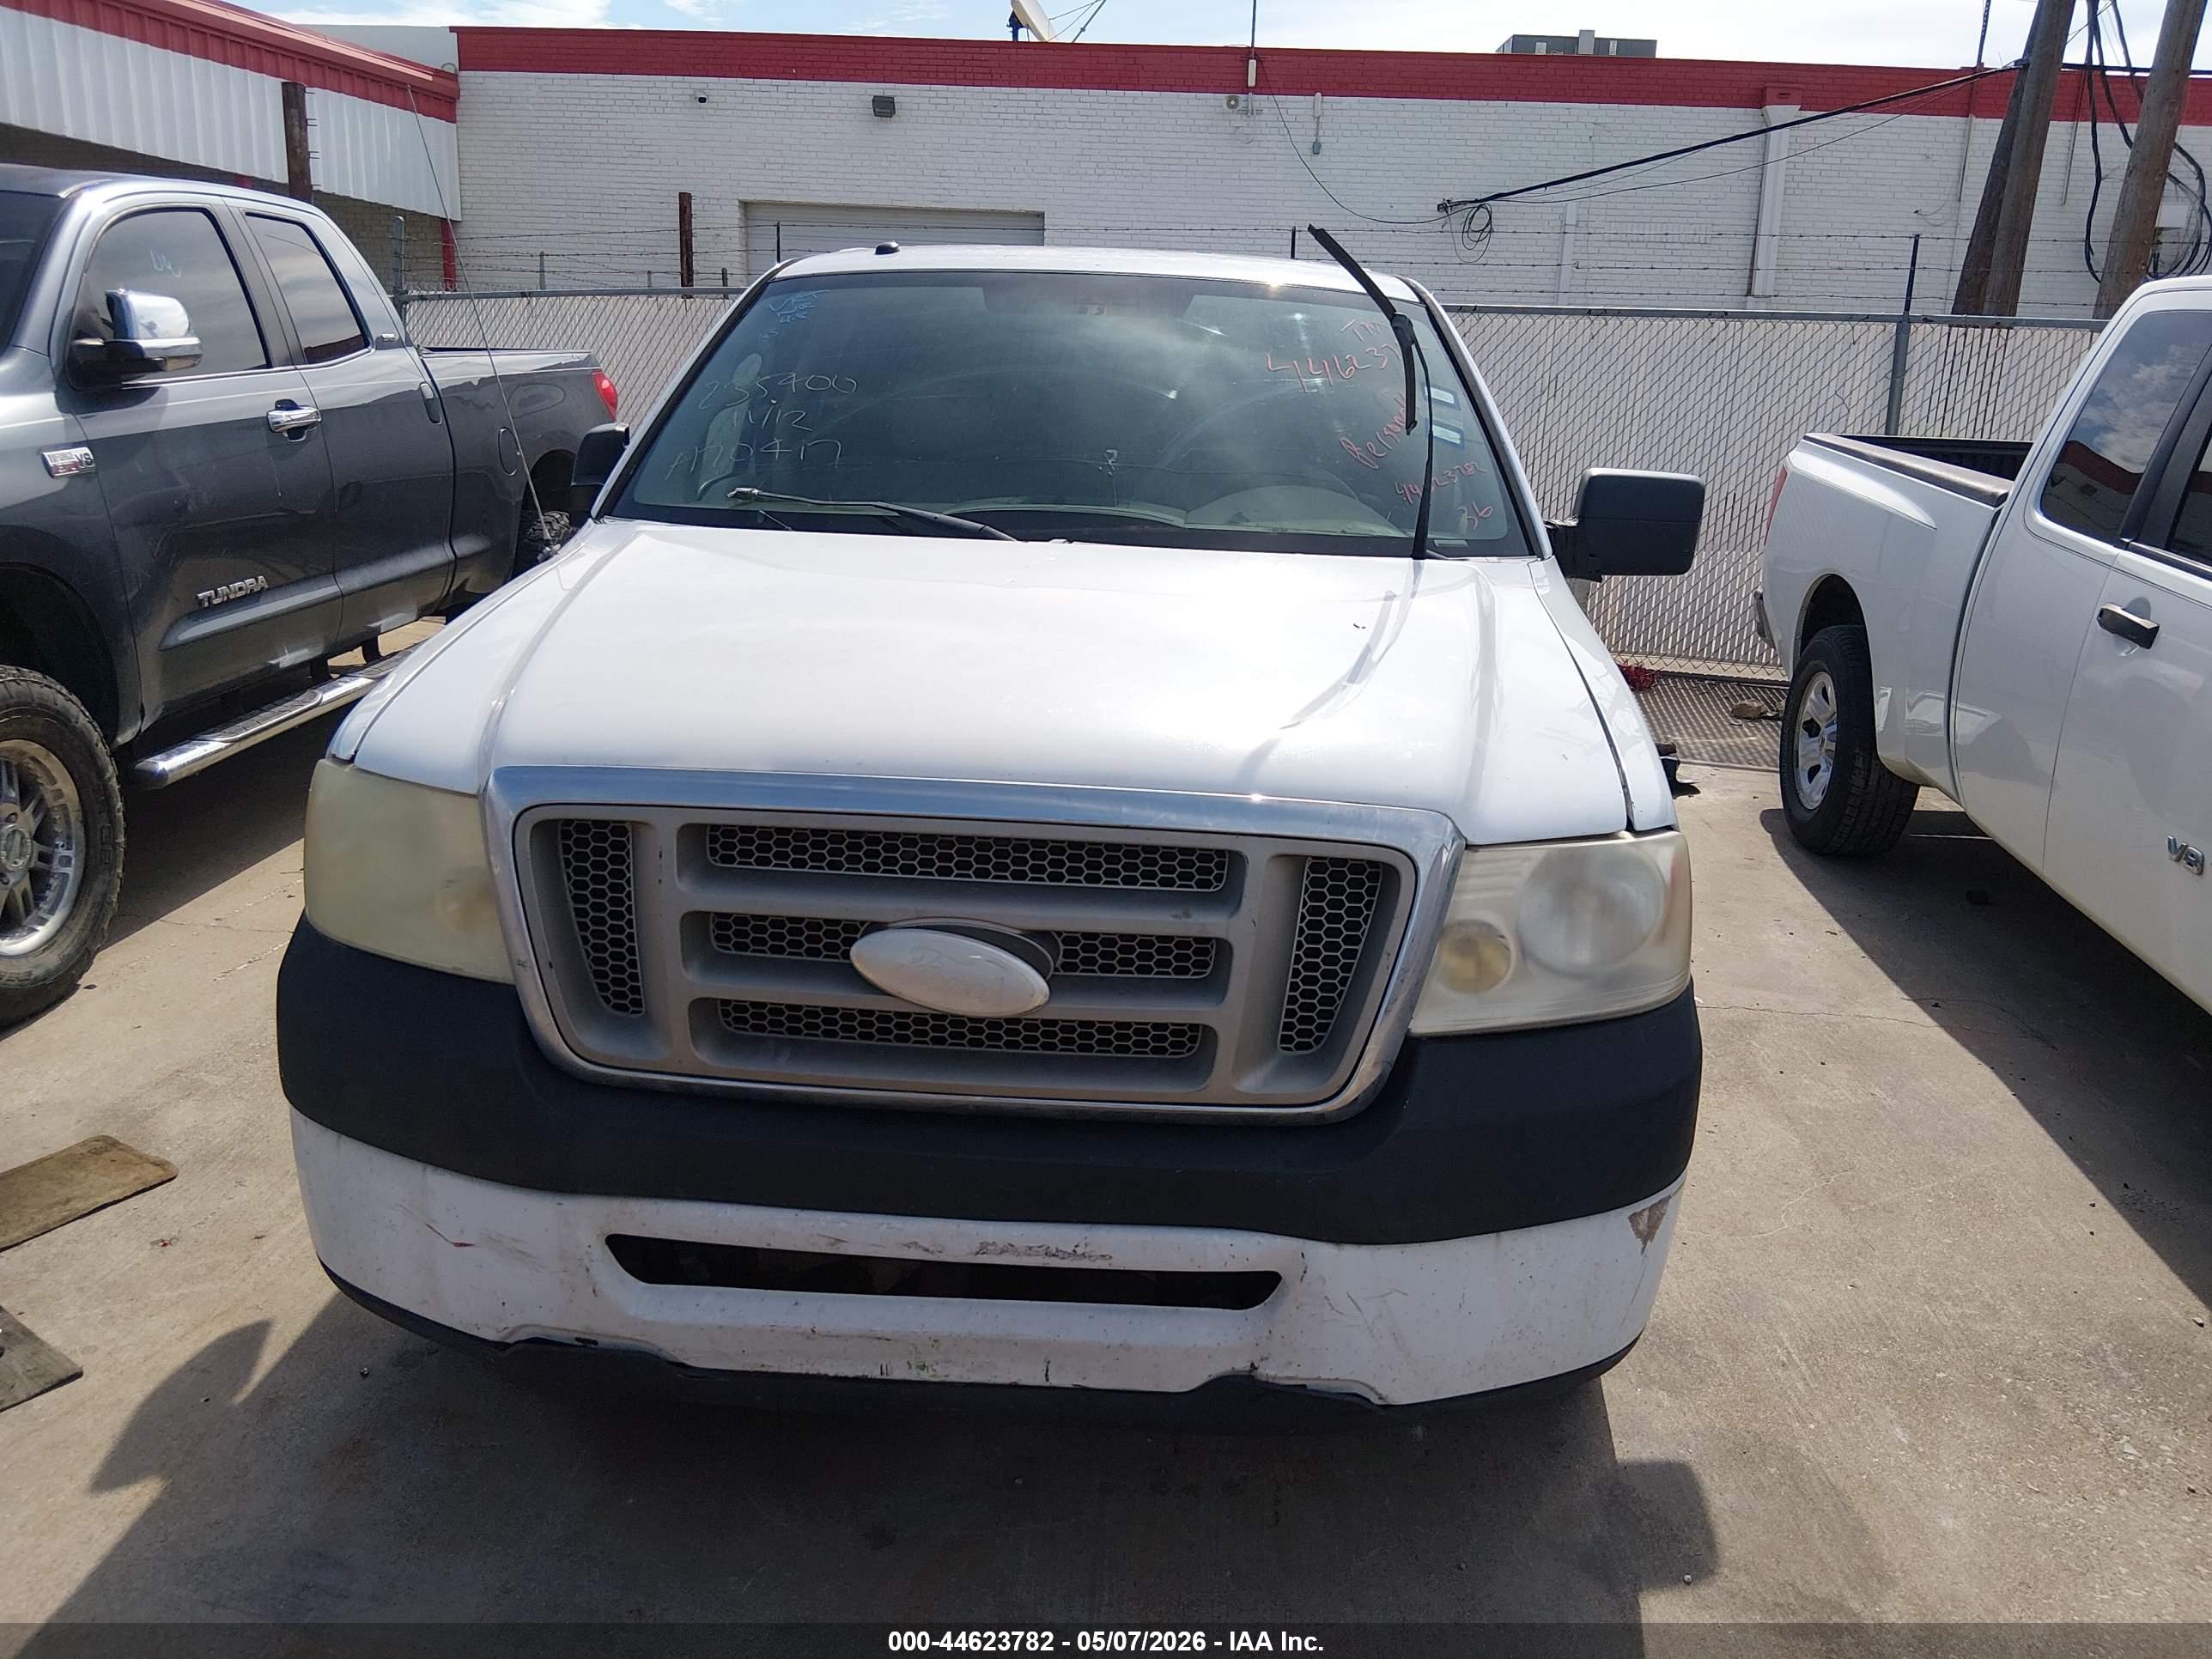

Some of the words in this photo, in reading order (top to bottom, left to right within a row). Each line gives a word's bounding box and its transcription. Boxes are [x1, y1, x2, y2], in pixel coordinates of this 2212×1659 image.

[1394, 460, 1489, 506] 4423782
[196, 575, 269, 608] TUNDRA
[2166, 835, 2205, 876] V8
